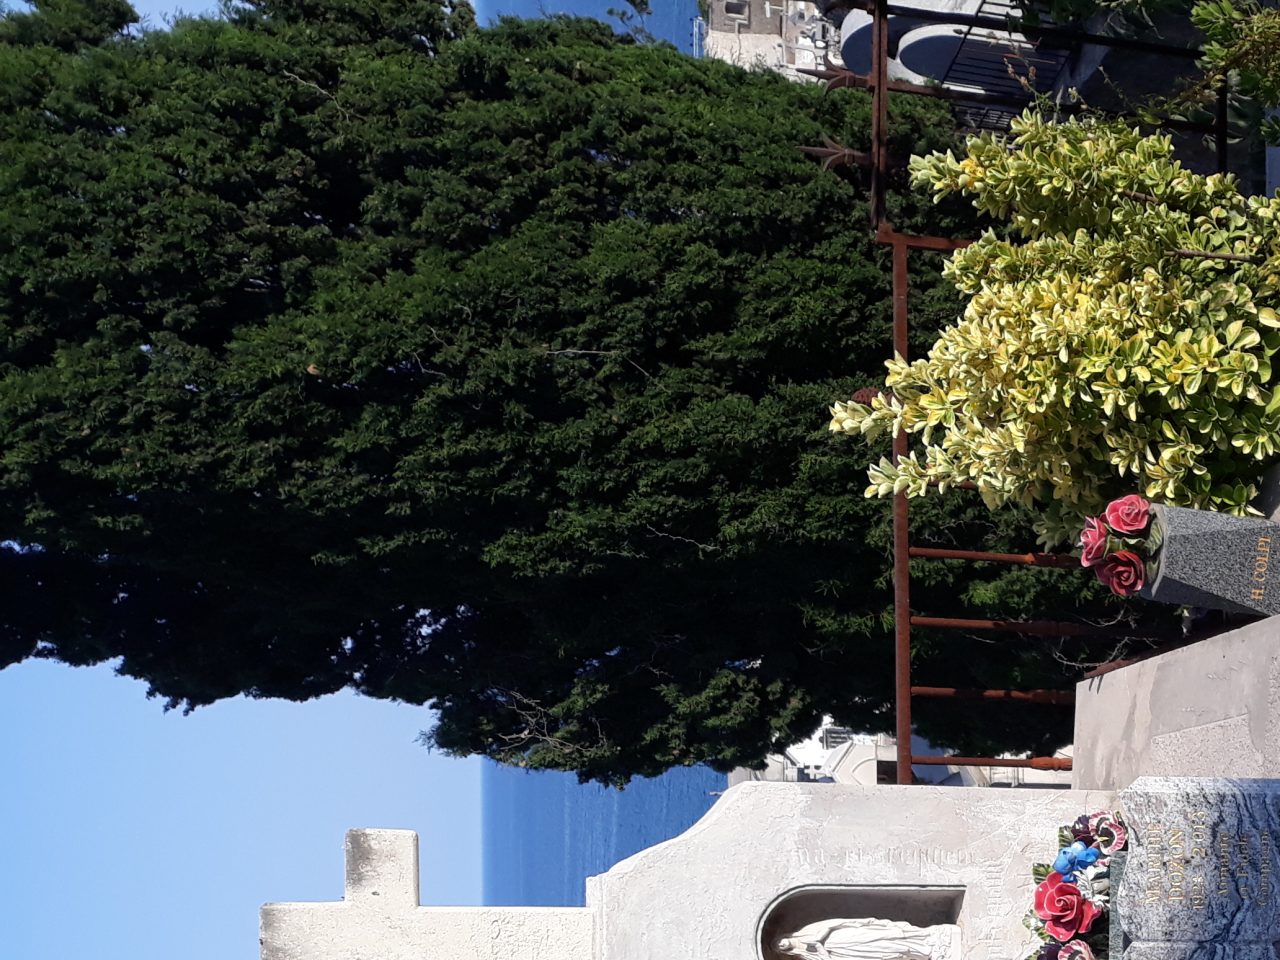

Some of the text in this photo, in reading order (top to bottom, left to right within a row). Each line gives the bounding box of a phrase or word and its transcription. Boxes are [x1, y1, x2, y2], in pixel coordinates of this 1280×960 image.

[1253, 536, 1271, 581] COLPI
[1145, 822, 1162, 905] MARTHE
[1168, 829, 1184, 900] DOZON
